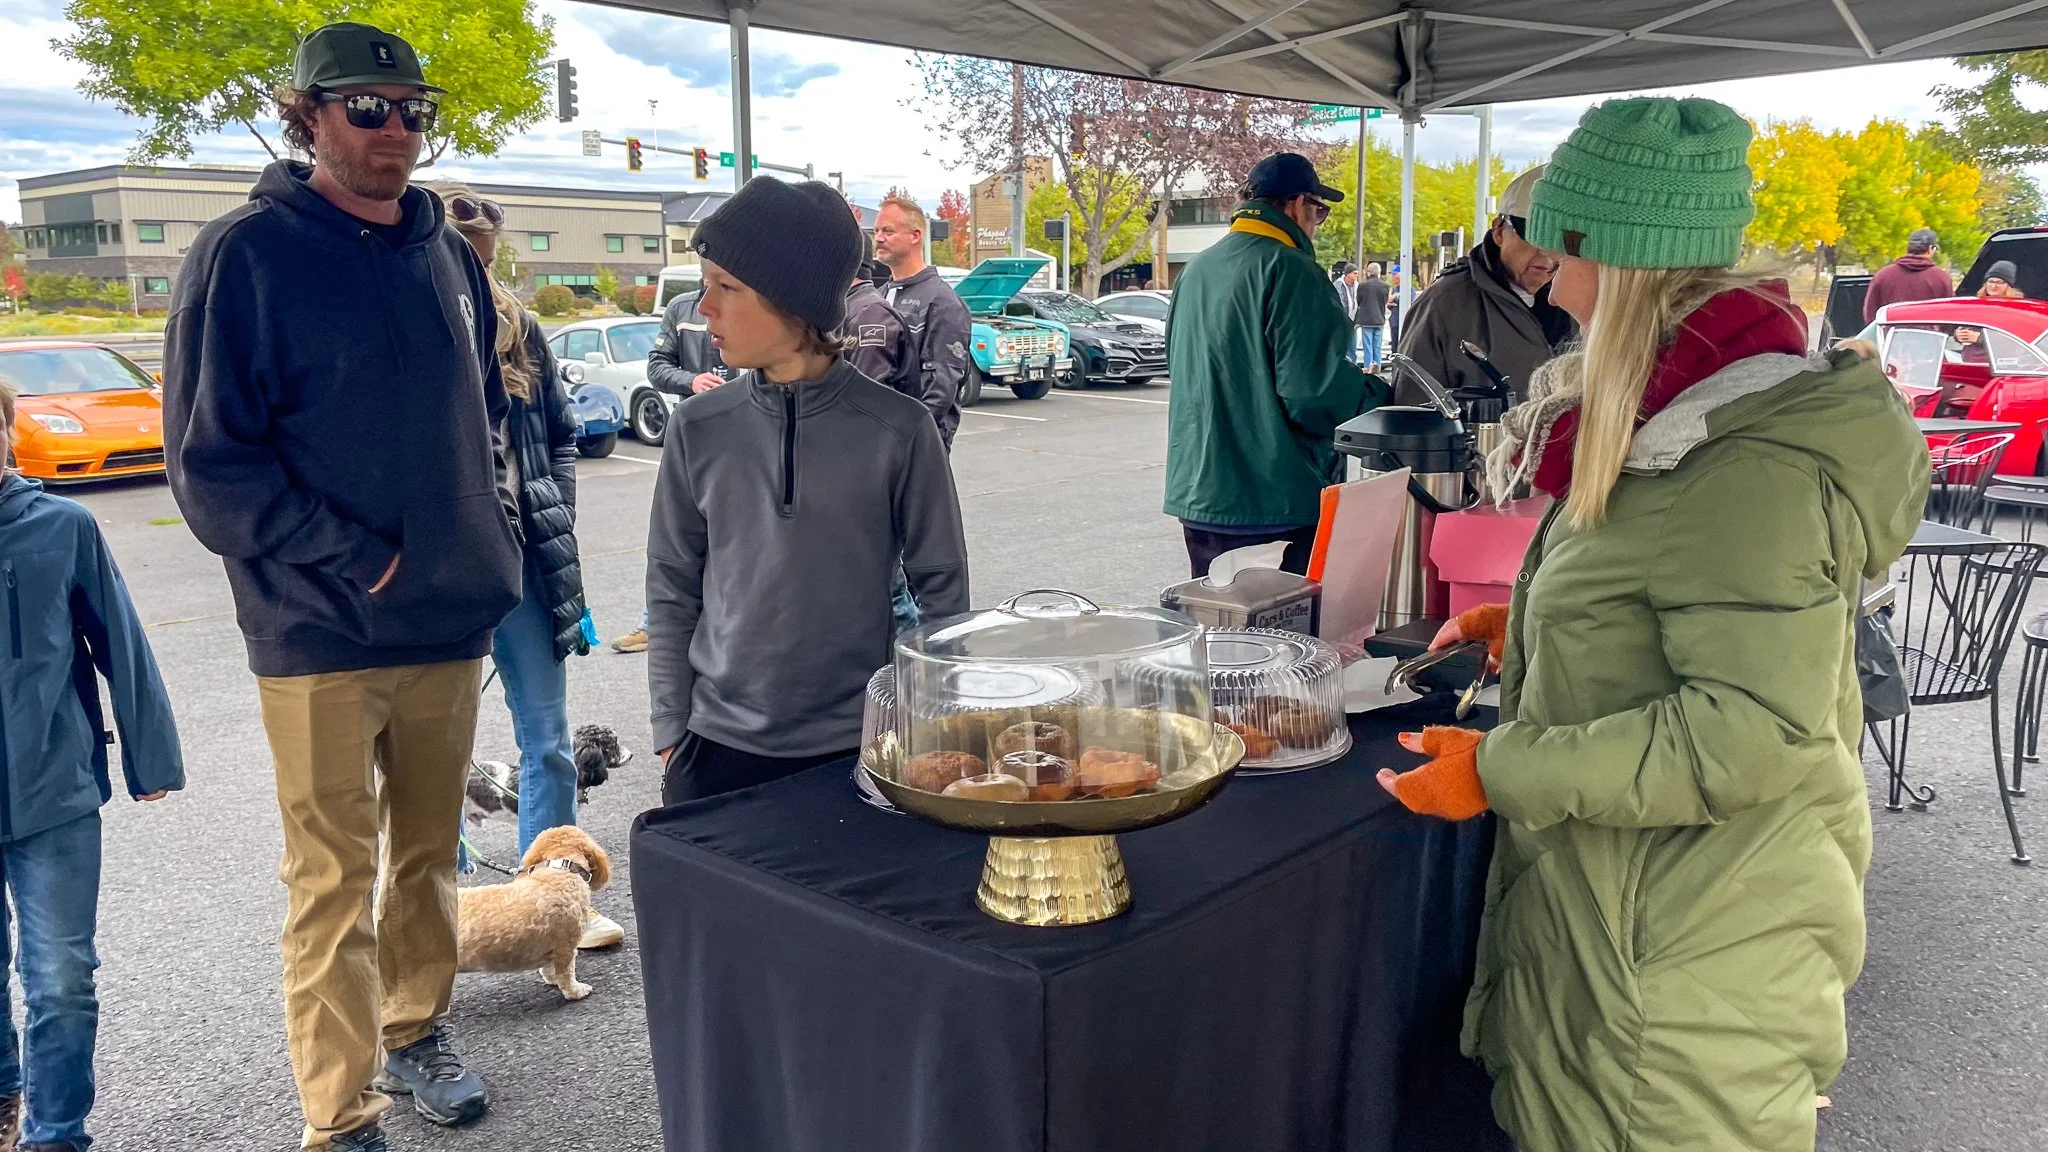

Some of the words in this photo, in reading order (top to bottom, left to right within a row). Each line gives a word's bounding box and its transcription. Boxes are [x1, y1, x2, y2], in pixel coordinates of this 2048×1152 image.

[1338, 105, 1361, 118] Cente
[1259, 615, 1278, 629] Cars
[1278, 609, 1284, 621] &
[1284, 603, 1309, 618] Coffee
